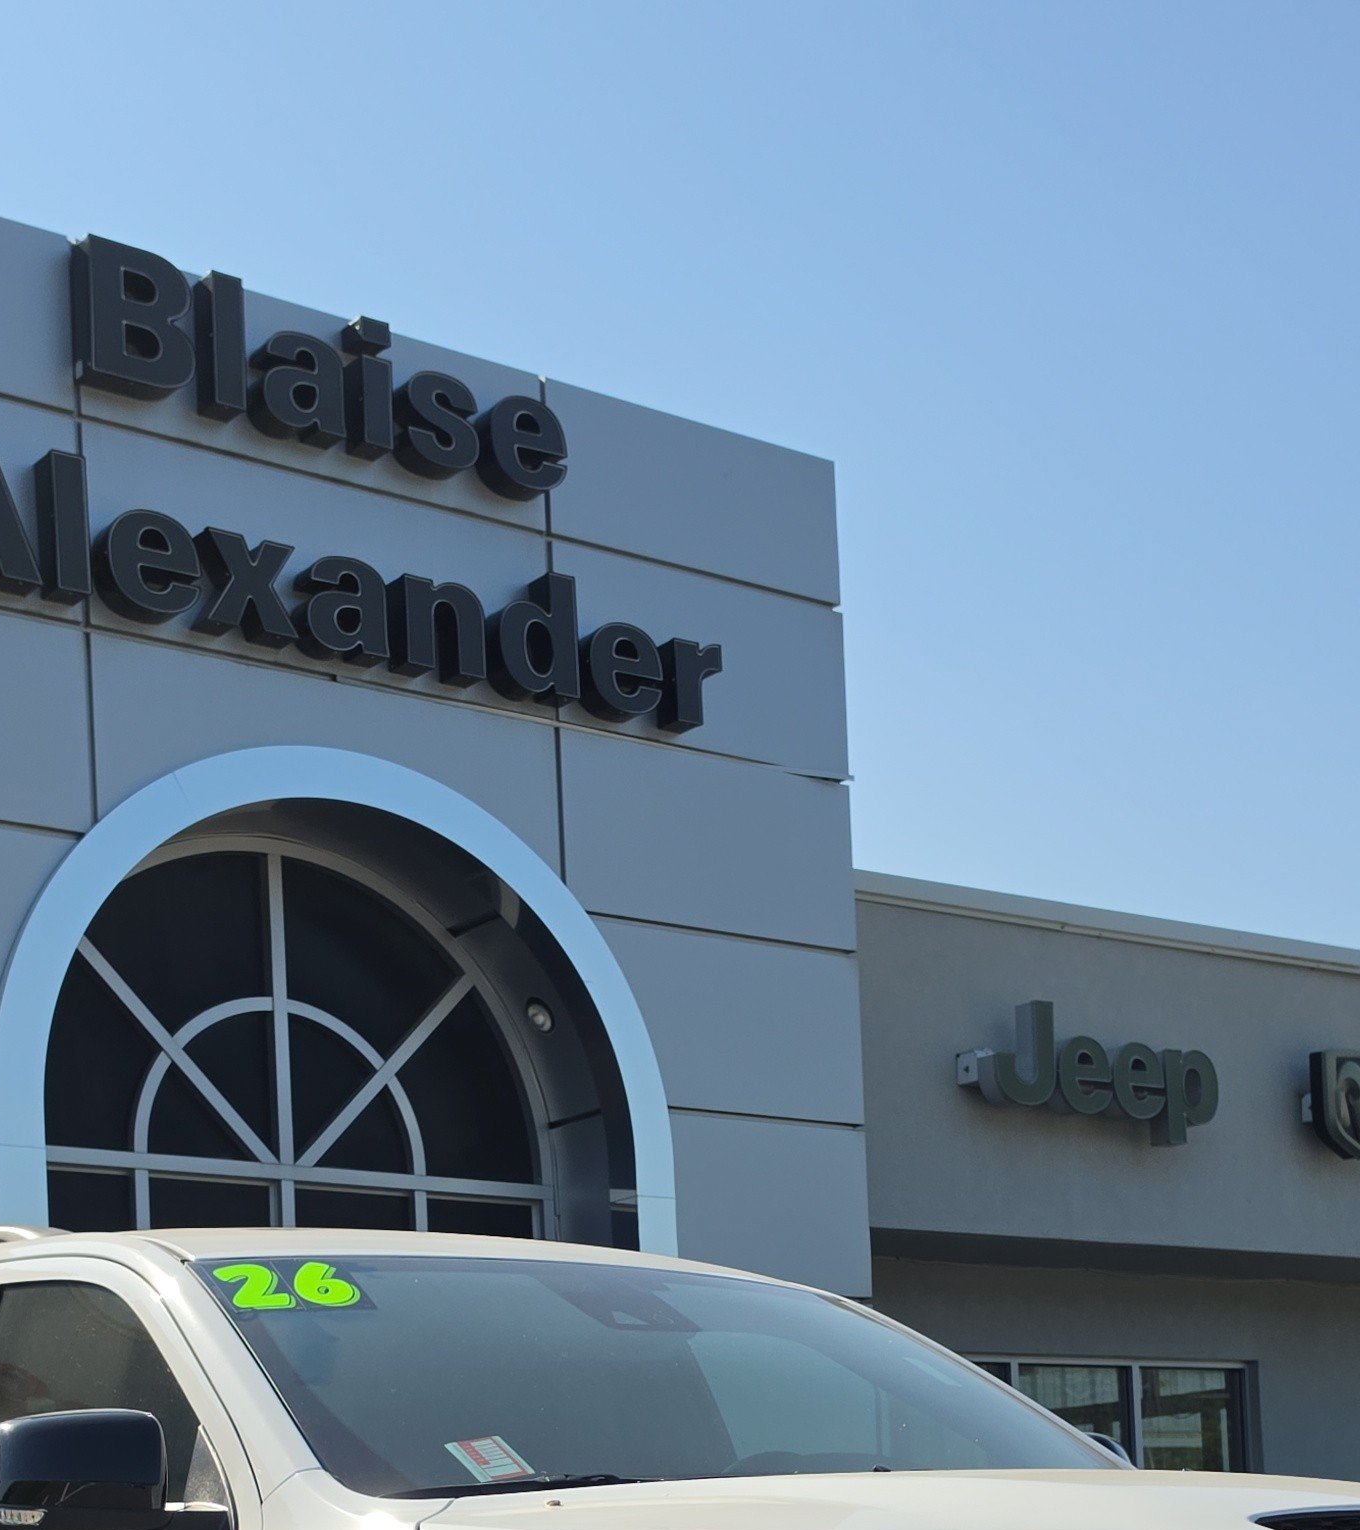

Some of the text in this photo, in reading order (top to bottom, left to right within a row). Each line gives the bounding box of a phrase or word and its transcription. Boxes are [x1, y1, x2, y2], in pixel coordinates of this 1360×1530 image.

[71, 234, 568, 502] Blaise
[980, 1000, 1220, 1147] Jeep
[213, 1261, 360, 1309] 26
